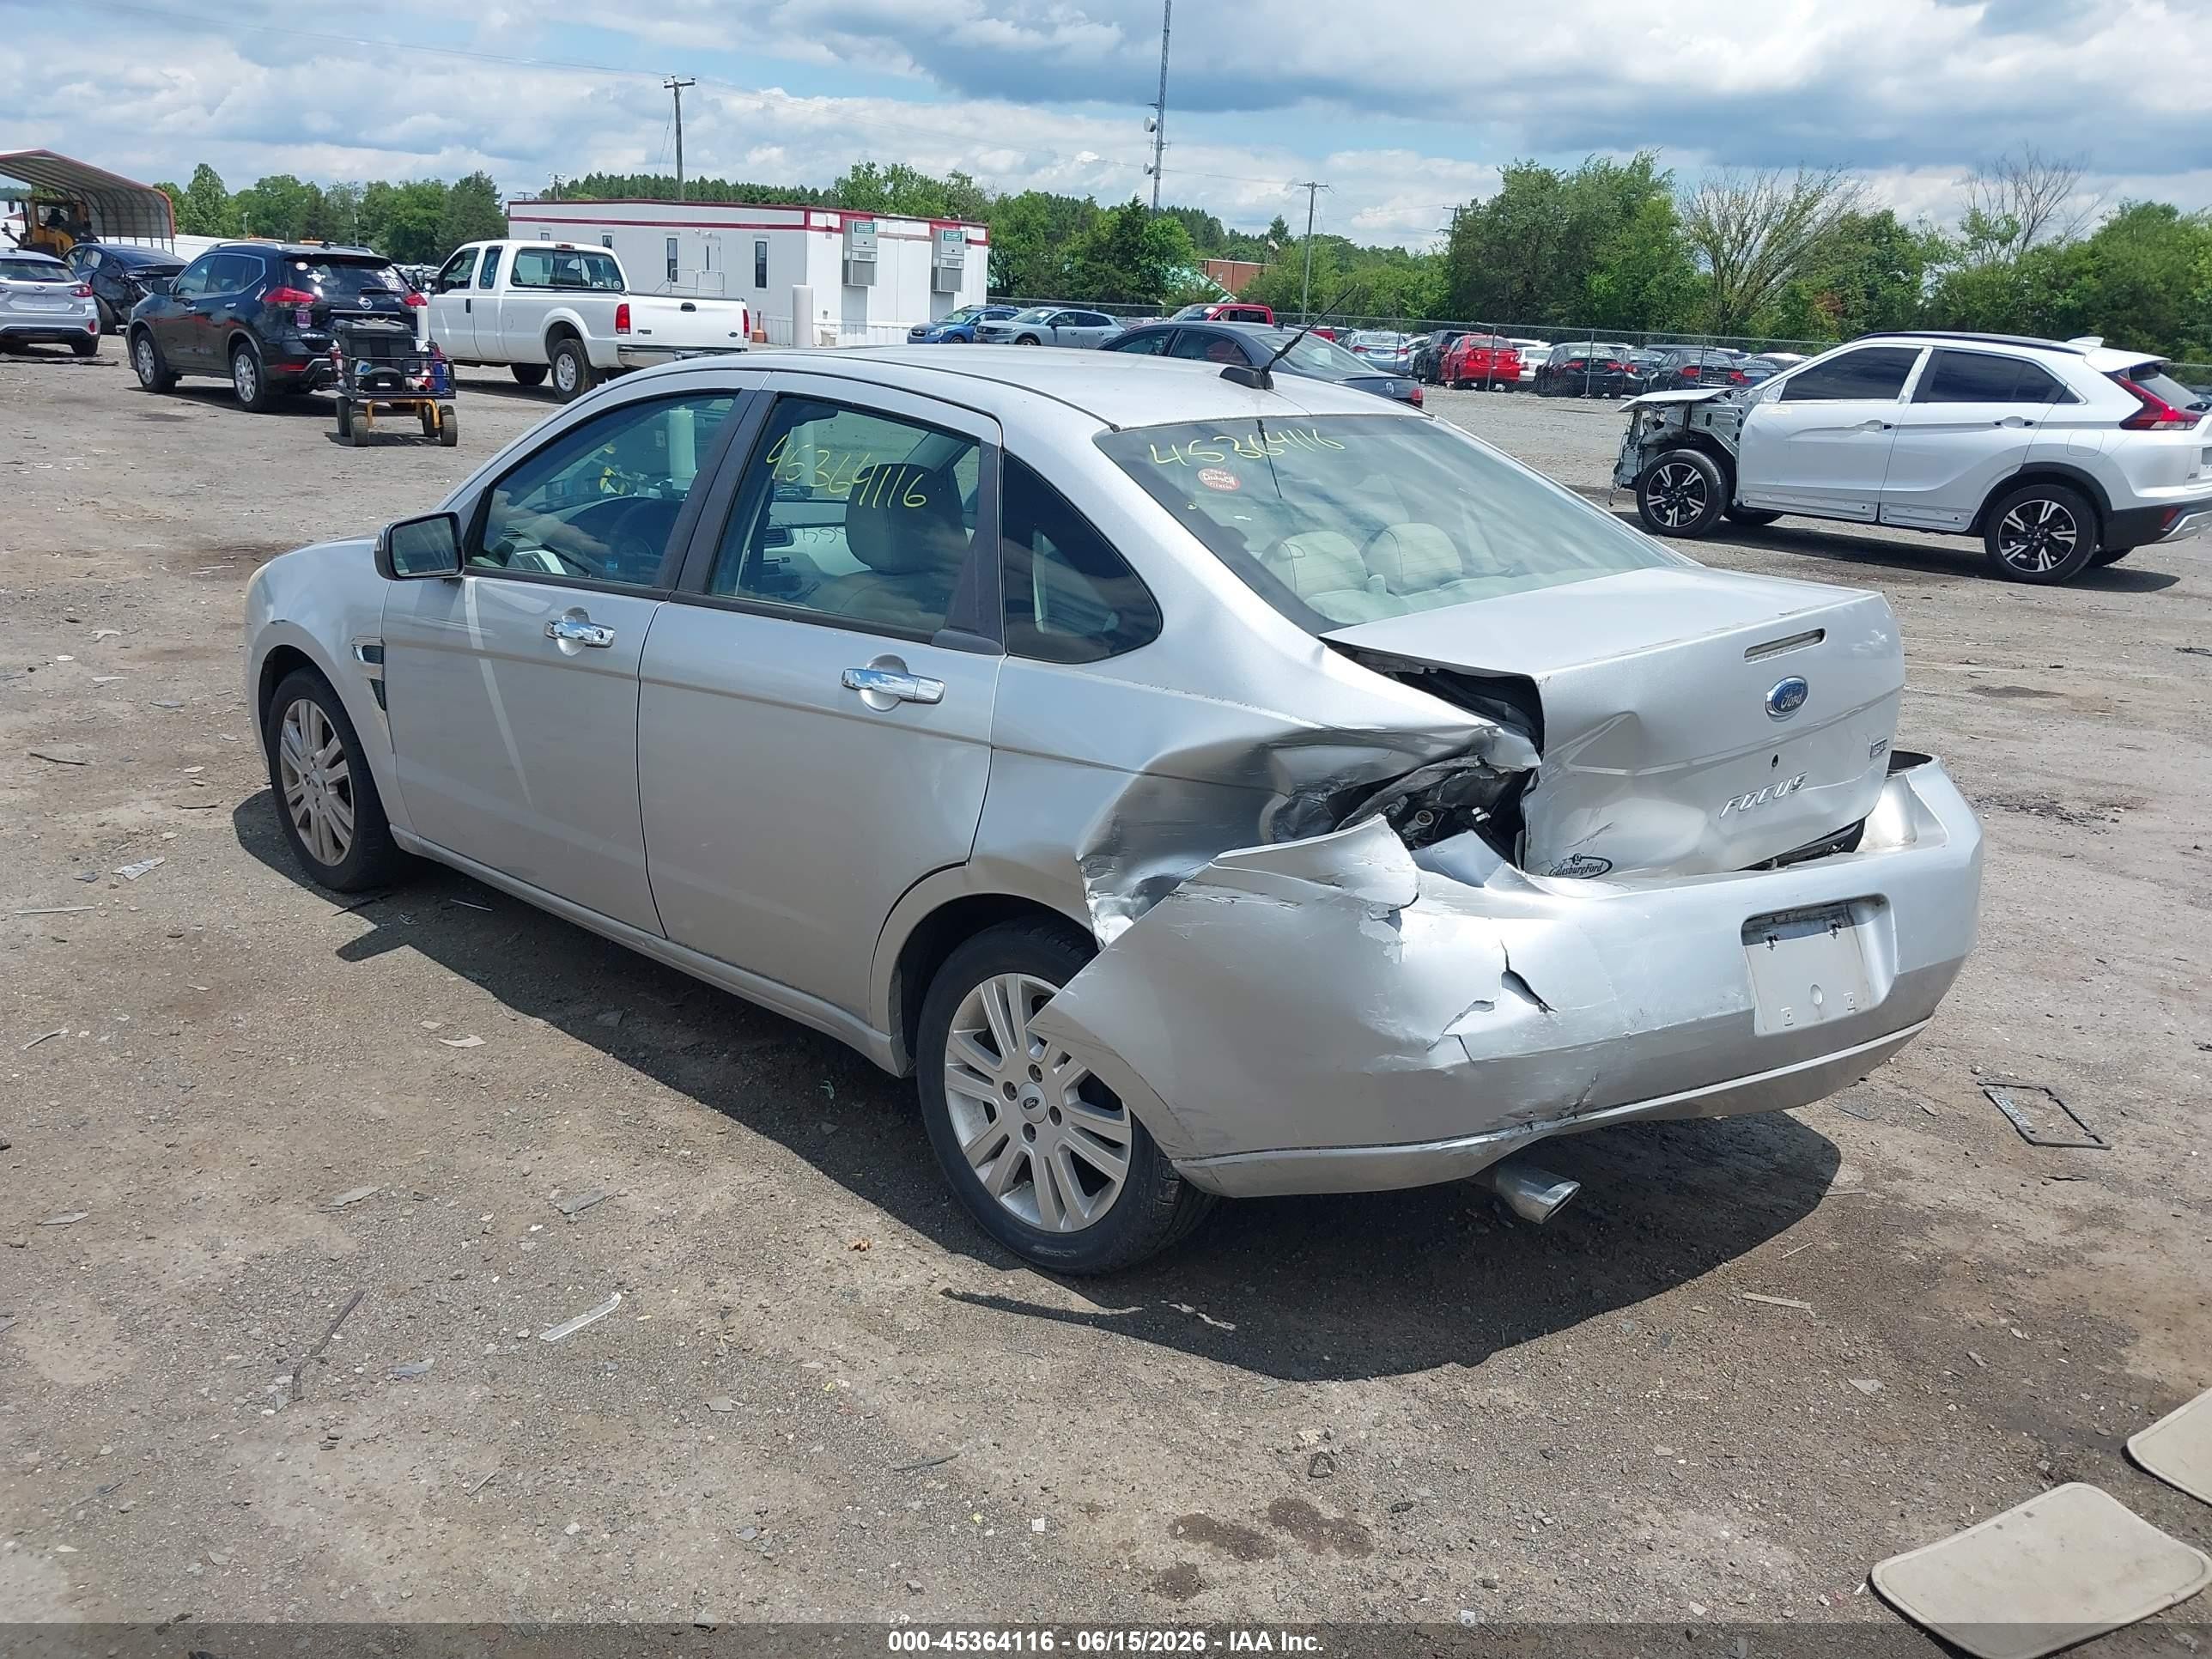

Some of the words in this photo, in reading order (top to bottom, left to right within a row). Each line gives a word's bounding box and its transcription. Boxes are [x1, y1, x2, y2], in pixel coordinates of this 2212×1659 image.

[1149, 428, 1346, 467] 45364116
[765, 433, 928, 509] 45364116
[1780, 686, 1804, 709] Ford
[1719, 771, 1808, 819] FOCUS
